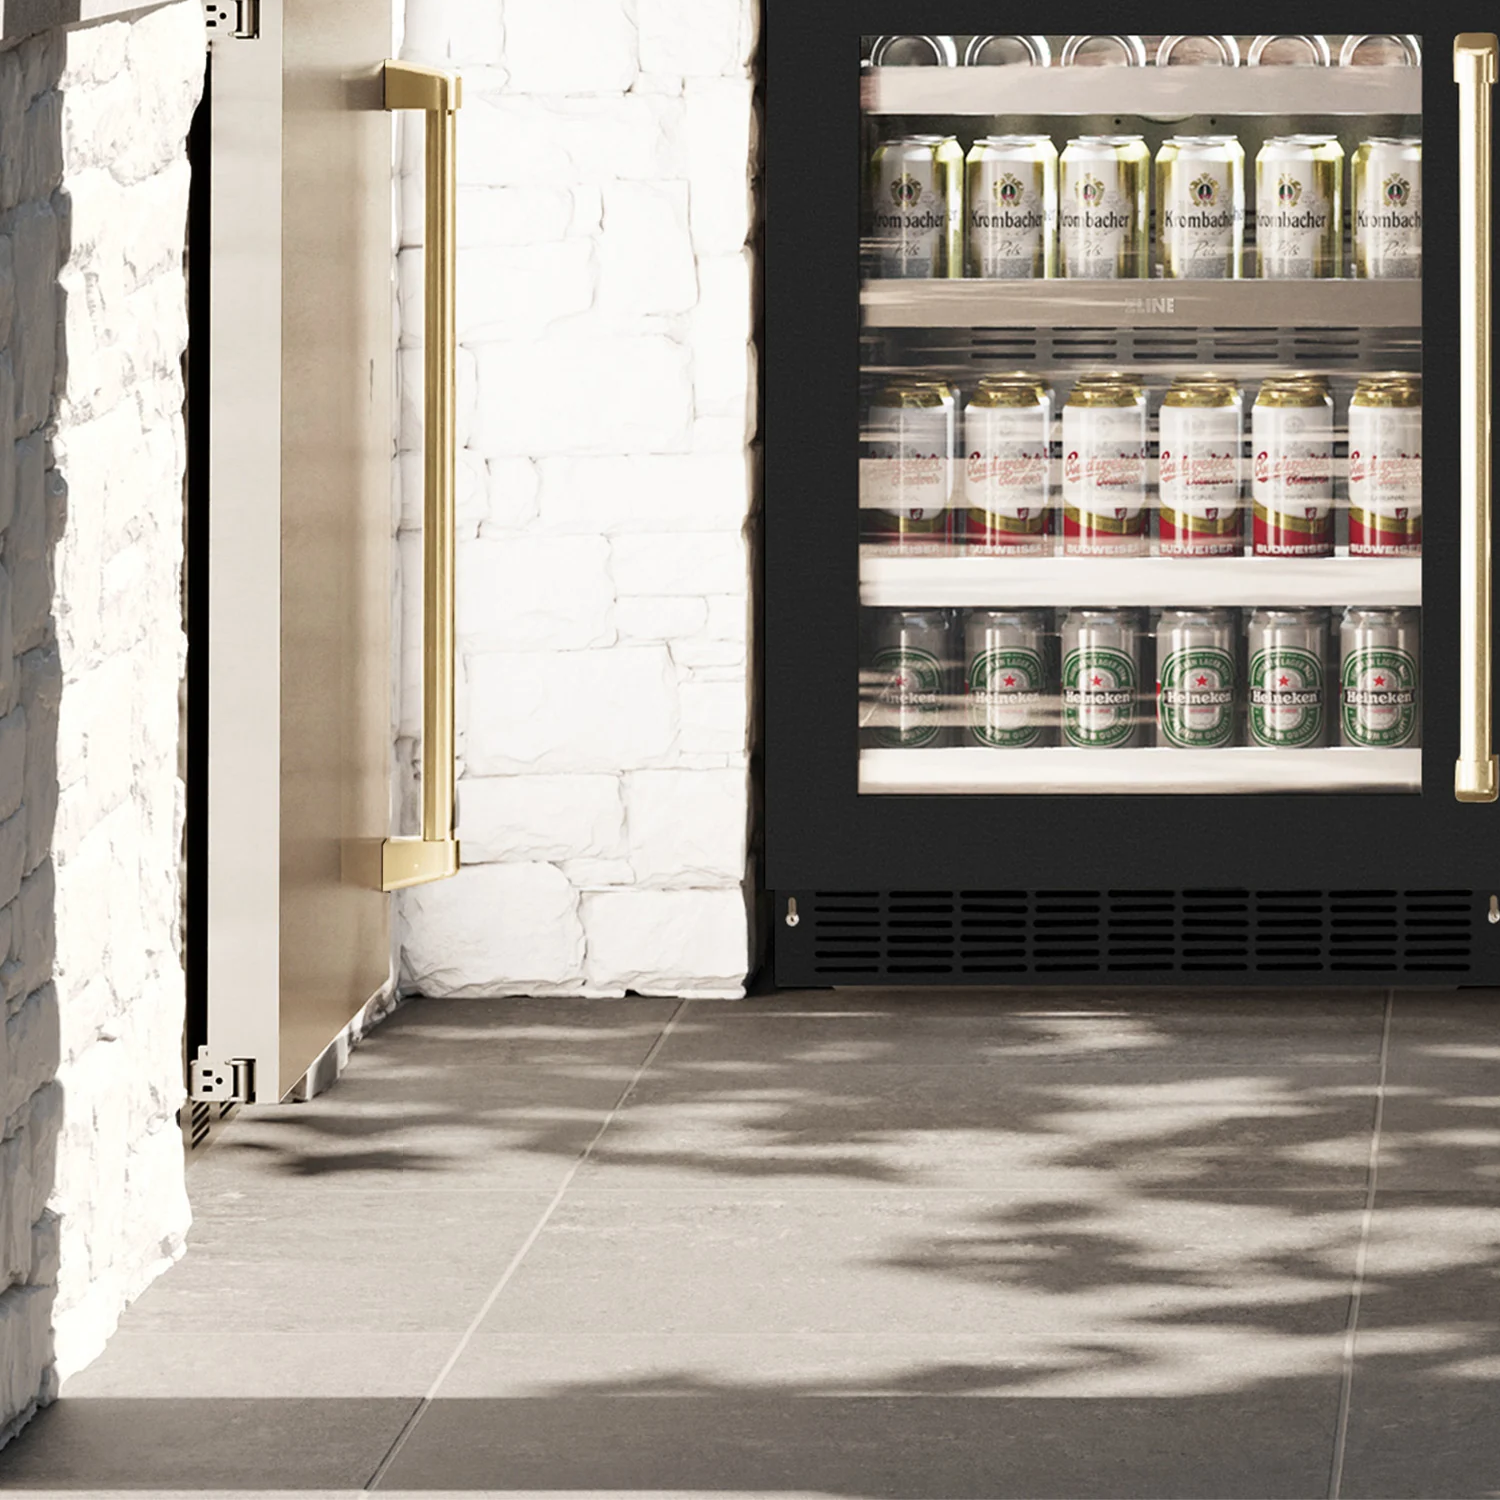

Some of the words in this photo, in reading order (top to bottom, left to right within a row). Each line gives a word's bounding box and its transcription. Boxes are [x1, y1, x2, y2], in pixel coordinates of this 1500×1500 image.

[1062, 210, 1130, 229] rombacher
[1258, 210, 1327, 229] rombacher
[1253, 690, 1317, 705] Heineken
[1347, 690, 1412, 705] Heineken
